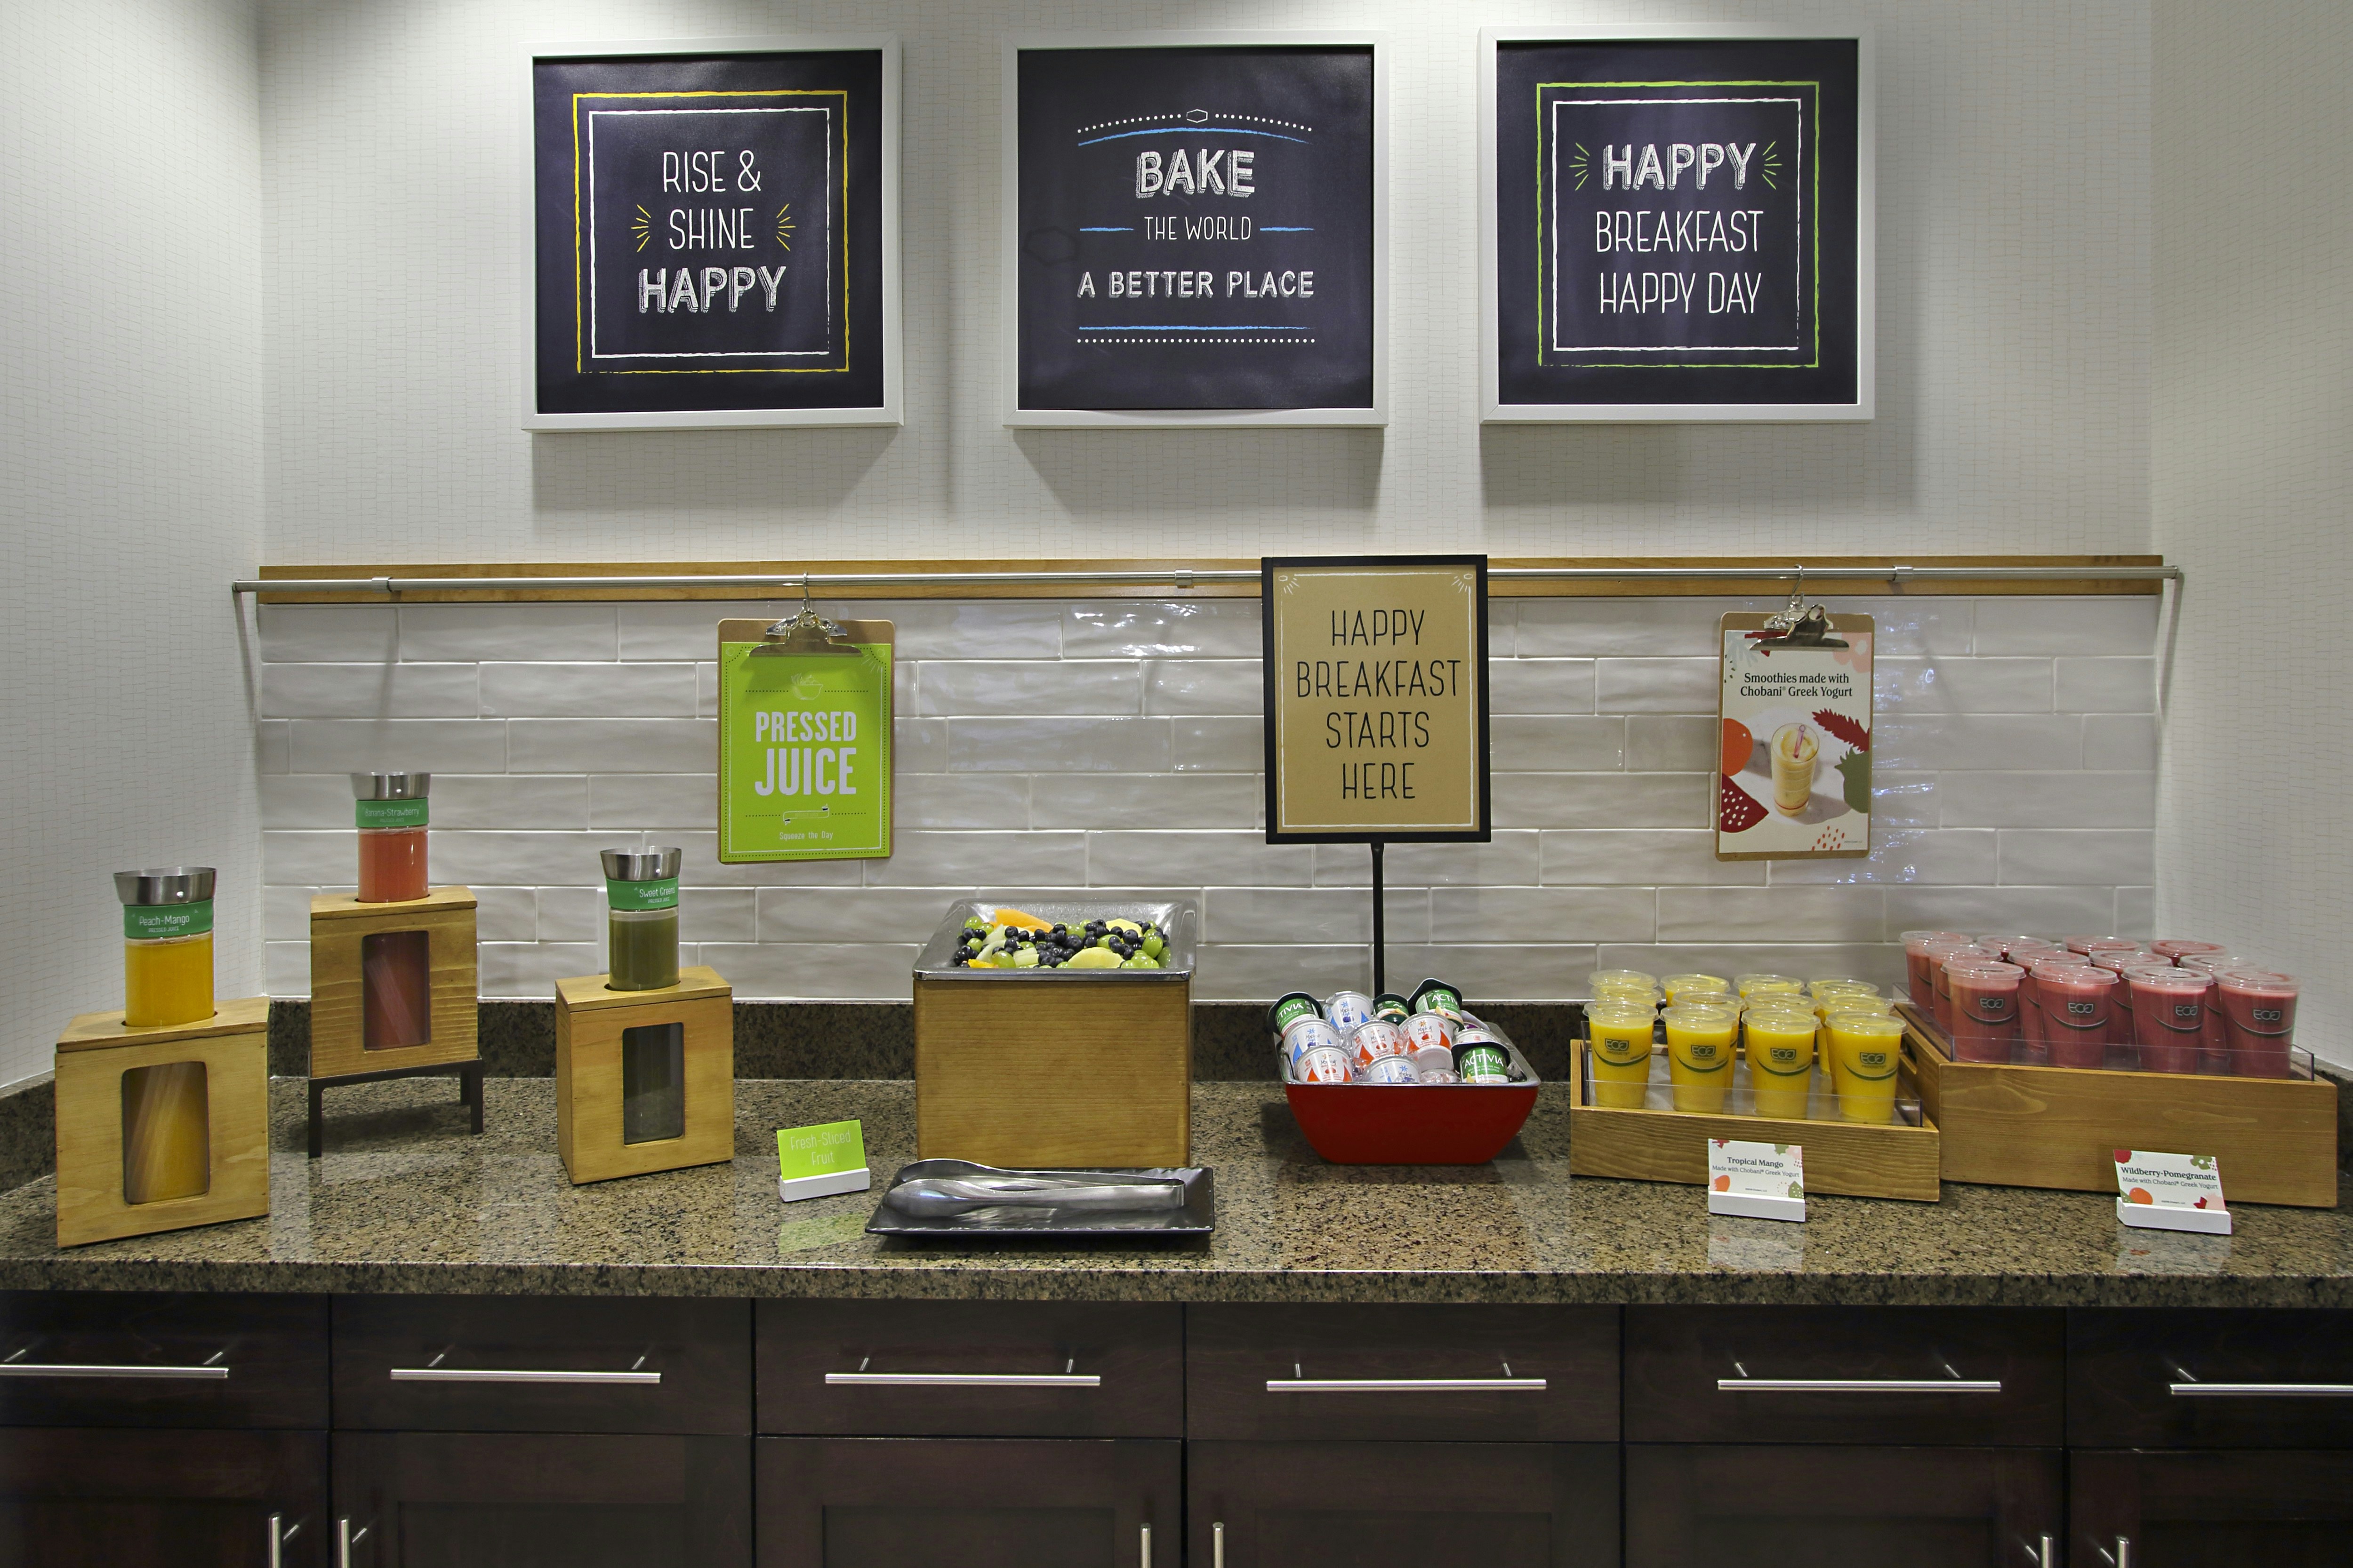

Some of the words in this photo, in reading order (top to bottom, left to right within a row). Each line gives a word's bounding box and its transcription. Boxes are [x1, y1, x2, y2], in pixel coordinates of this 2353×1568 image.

[663, 151, 726, 193] RISE
[738, 150, 761, 192] &
[1135, 148, 1255, 199] BAKE
[1603, 143, 1757, 191] HAPPY
[669, 208, 755, 251] SHINE
[1144, 216, 1177, 240] THE
[1185, 216, 1252, 240] WORLD
[1596, 210, 1764, 252] BREAKFAST
[638, 266, 787, 313] HAPPY
[1077, 272, 1095, 298] A
[1109, 271, 1214, 298] BETTER
[1227, 271, 1314, 298] PLACE
[1600, 272, 1695, 314] HAPPY
[1708, 272, 1761, 314] DAY
[1332, 609, 1425, 646] HAPPY
[1297, 660, 1461, 697] BREAKFAST
[1744, 672, 1797, 683] Smoothies
[1799, 673, 1826, 683] made
[1828, 673, 1849, 683] with
[1789, 686, 1818, 696] Greek
[1821, 687, 1853, 699] Yogurt
[756, 712, 857, 742] PRESSED
[1326, 712, 1429, 748] STARTS
[755, 747, 857, 796] JUICE
[1343, 762, 1415, 799] HERE
[365, 808, 420, 817] Banana-Strawberry
[779, 832, 805, 841] Squeeze
[821, 831, 833, 840] Day
[639, 888, 658, 898] Sweet
[659, 887, 675, 896] Greens
[139, 915, 190, 926] Peach-Mango
[1980, 998, 2004, 1008] ECO
[2068, 1002, 2094, 1014] ECO
[2176, 1006, 2198, 1016] ECO
[2253, 1009, 2281, 1021] ECO
[1606, 1039, 1628, 1050] ECO
[1692, 1045, 1715, 1056] ECO
[1464, 1054, 1504, 1069] ACTVIA
[1771, 1048, 1795, 1060] ECO
[1860, 1053, 1885, 1064] ECO
[790, 1129, 851, 1151] Fresh-Sliced
[811, 1151, 835, 1166] Fruit
[1727, 1156, 1757, 1166] Tropical
[1759, 1160, 1783, 1169] Mango
[2120, 1167, 2216, 1181] Wildberry-Pomegranate
